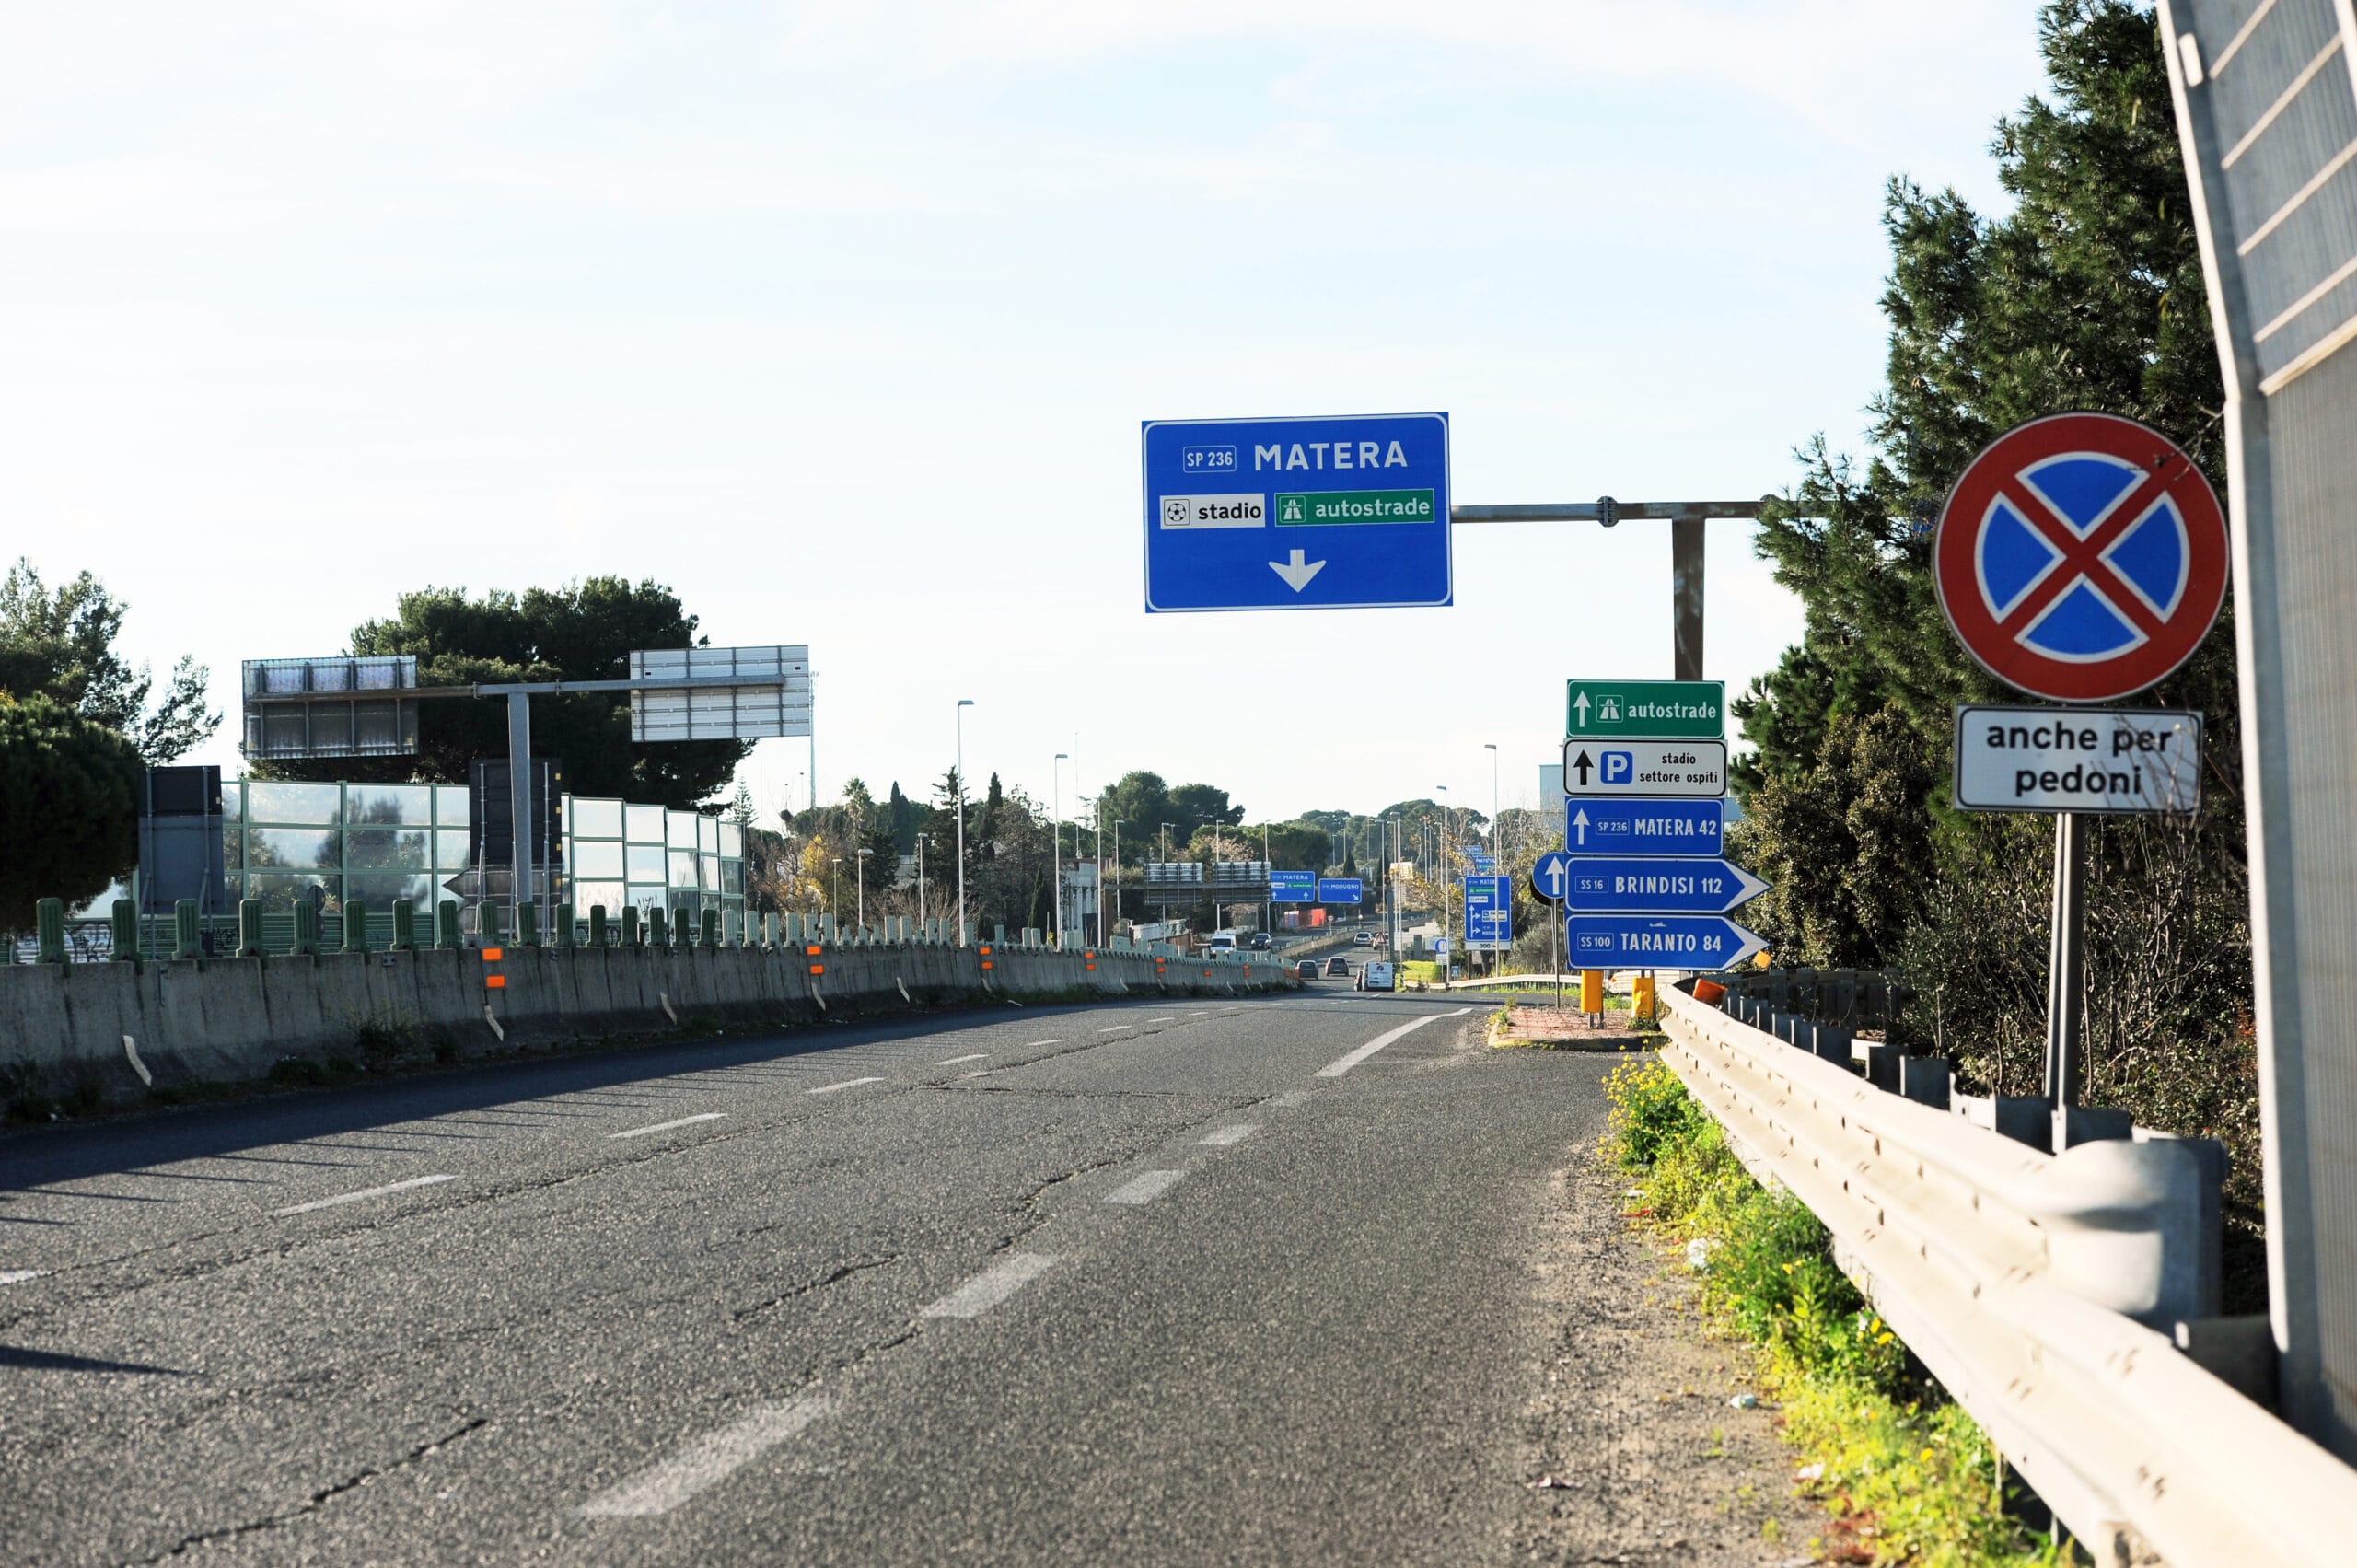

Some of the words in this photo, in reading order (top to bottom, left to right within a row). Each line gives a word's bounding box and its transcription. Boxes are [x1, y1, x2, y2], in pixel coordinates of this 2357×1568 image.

[1186, 452, 1204, 468] SP
[1207, 450, 1234, 467] 236
[1254, 440, 1409, 471] MATERA
[1198, 502, 1262, 520] stadio
[1315, 497, 1430, 517] autostrade
[1628, 701, 1717, 719] autostrade
[1986, 720, 2098, 750] anche
[2112, 726, 2174, 758] per
[1661, 752, 1696, 765] stadio
[1639, 771, 1680, 783] settore
[1686, 772, 1718, 785] ospiti
[2014, 763, 2142, 797] pedoni
[1597, 821, 1608, 832] SP
[1610, 821, 1628, 832] 236
[1634, 818, 1695, 836] MATERA
[1699, 819, 1717, 836] 42
[1580, 879, 1592, 889] SS
[1594, 879, 1604, 889] 16
[1615, 876, 1694, 895] BRINDISI
[1701, 877, 1723, 894] 112
[1580, 935, 1592, 947] SS
[1594, 935, 1611, 947] 100
[1620, 932, 1697, 952] TARANTO
[1703, 935, 1722, 952] 84
